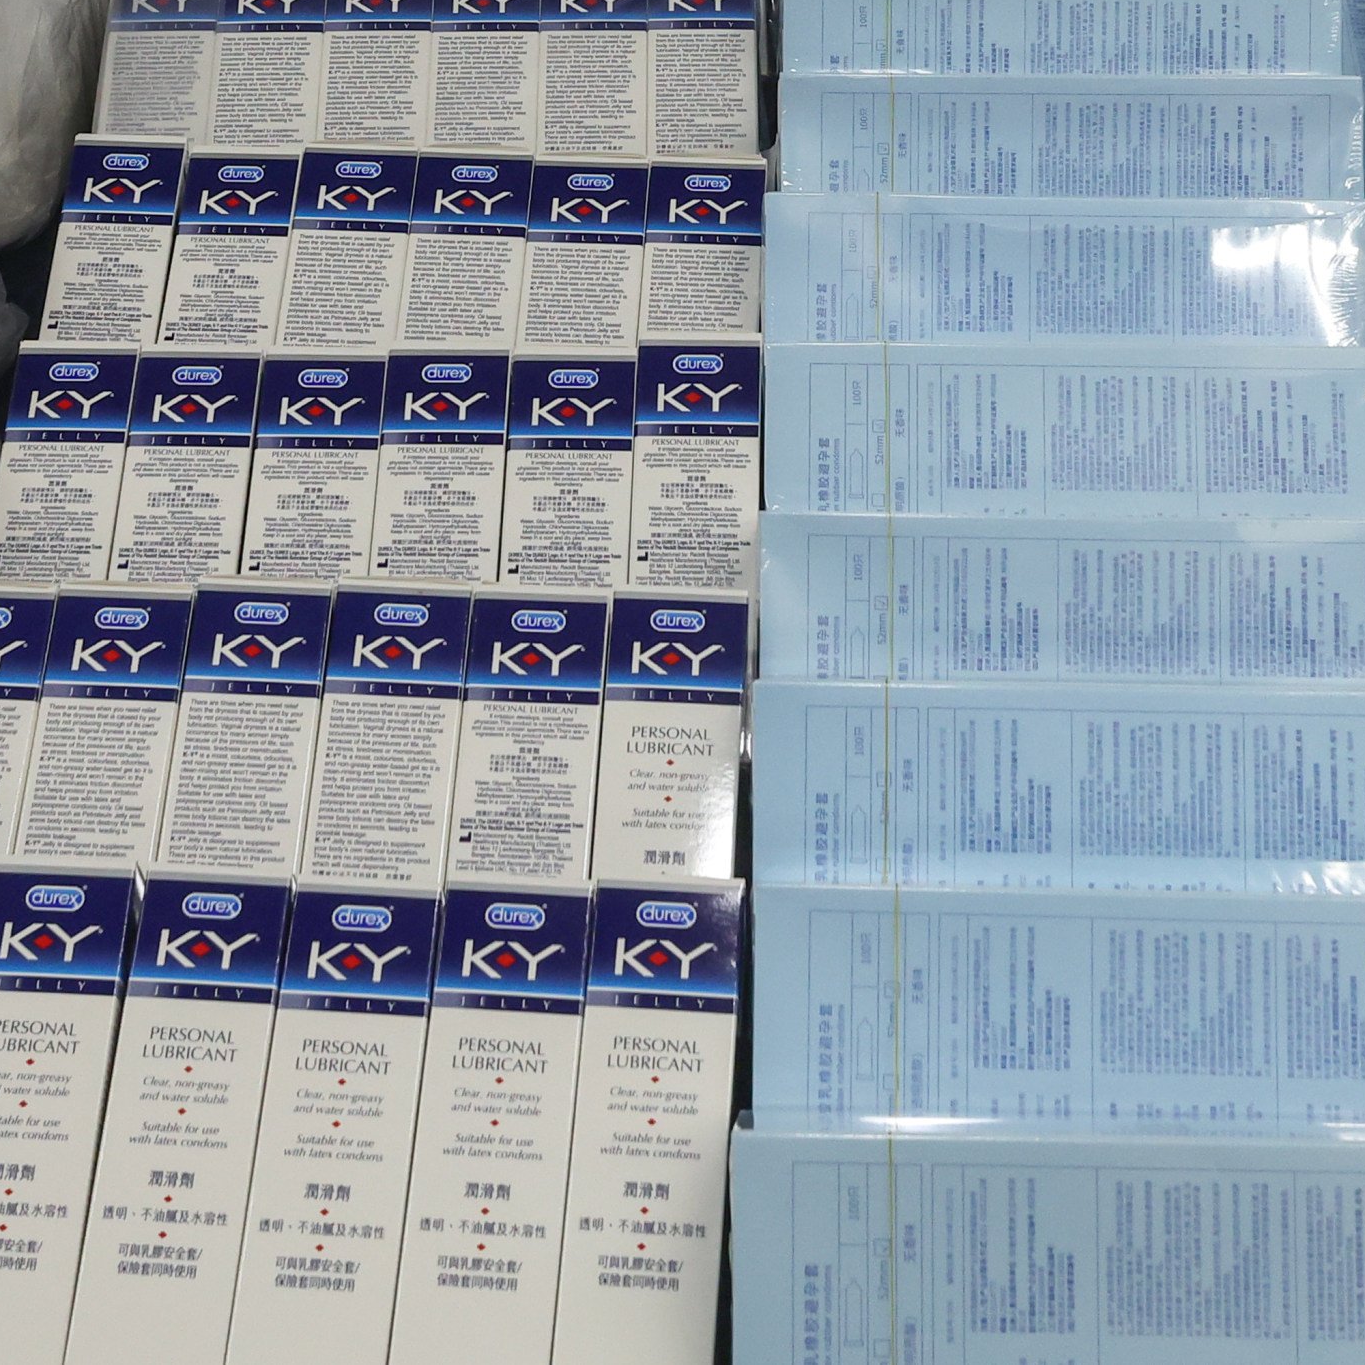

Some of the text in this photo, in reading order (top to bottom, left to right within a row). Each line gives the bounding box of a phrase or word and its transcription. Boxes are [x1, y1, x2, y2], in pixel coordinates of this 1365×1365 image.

[106, 154, 145, 169] durex
[339, 162, 378, 177] durex
[221, 166, 260, 181] durex
[455, 166, 494, 181] durex
[571, 174, 610, 189] durex
[688, 176, 727, 191] durex
[52, 364, 95, 380] durex
[425, 365, 468, 381] durex
[676, 356, 720, 373] durex
[175, 367, 219, 384] durex
[301, 370, 345, 387] durex
[551, 371, 595, 387] durex
[98, 609, 146, 628] durex
[237, 604, 285, 622] durex
[377, 605, 425, 624] durex
[515, 612, 563, 630] durex
[654, 612, 702, 630] durex
[632, 726, 712, 740] PERSONAL
[627, 741, 714, 756] LUBRICANT
[29, 887, 81, 909] durex
[186, 895, 237, 917] durex
[336, 907, 387, 929] durex
[489, 905, 541, 928] durex
[640, 903, 692, 926] durex
[154, 985, 244, 999] JELLY
[305, 998, 396, 1011] JELLY
[461, 997, 552, 1010] JELLY
[615, 994, 704, 1009] JELLY
[149, 1025, 235, 1045] PERSONAL
[613, 1035, 700, 1053] PERSONAL
[142, 1044, 238, 1063] LUBRICANT
[302, 1039, 388, 1057] PERSONAL
[458, 1037, 545, 1056] PERSONAL
[295, 1057, 391, 1076] LUBRICANT
[452, 1055, 548, 1074] LUBRICANT
[607, 1054, 704, 1072] LUBRICANT
[148, 1169, 194, 1189] 潤滑劑
[304, 1183, 351, 1202] 潤滑劑
[464, 1183, 511, 1202] 潤滑劑
[623, 1181, 670, 1200] 潤滑劑
